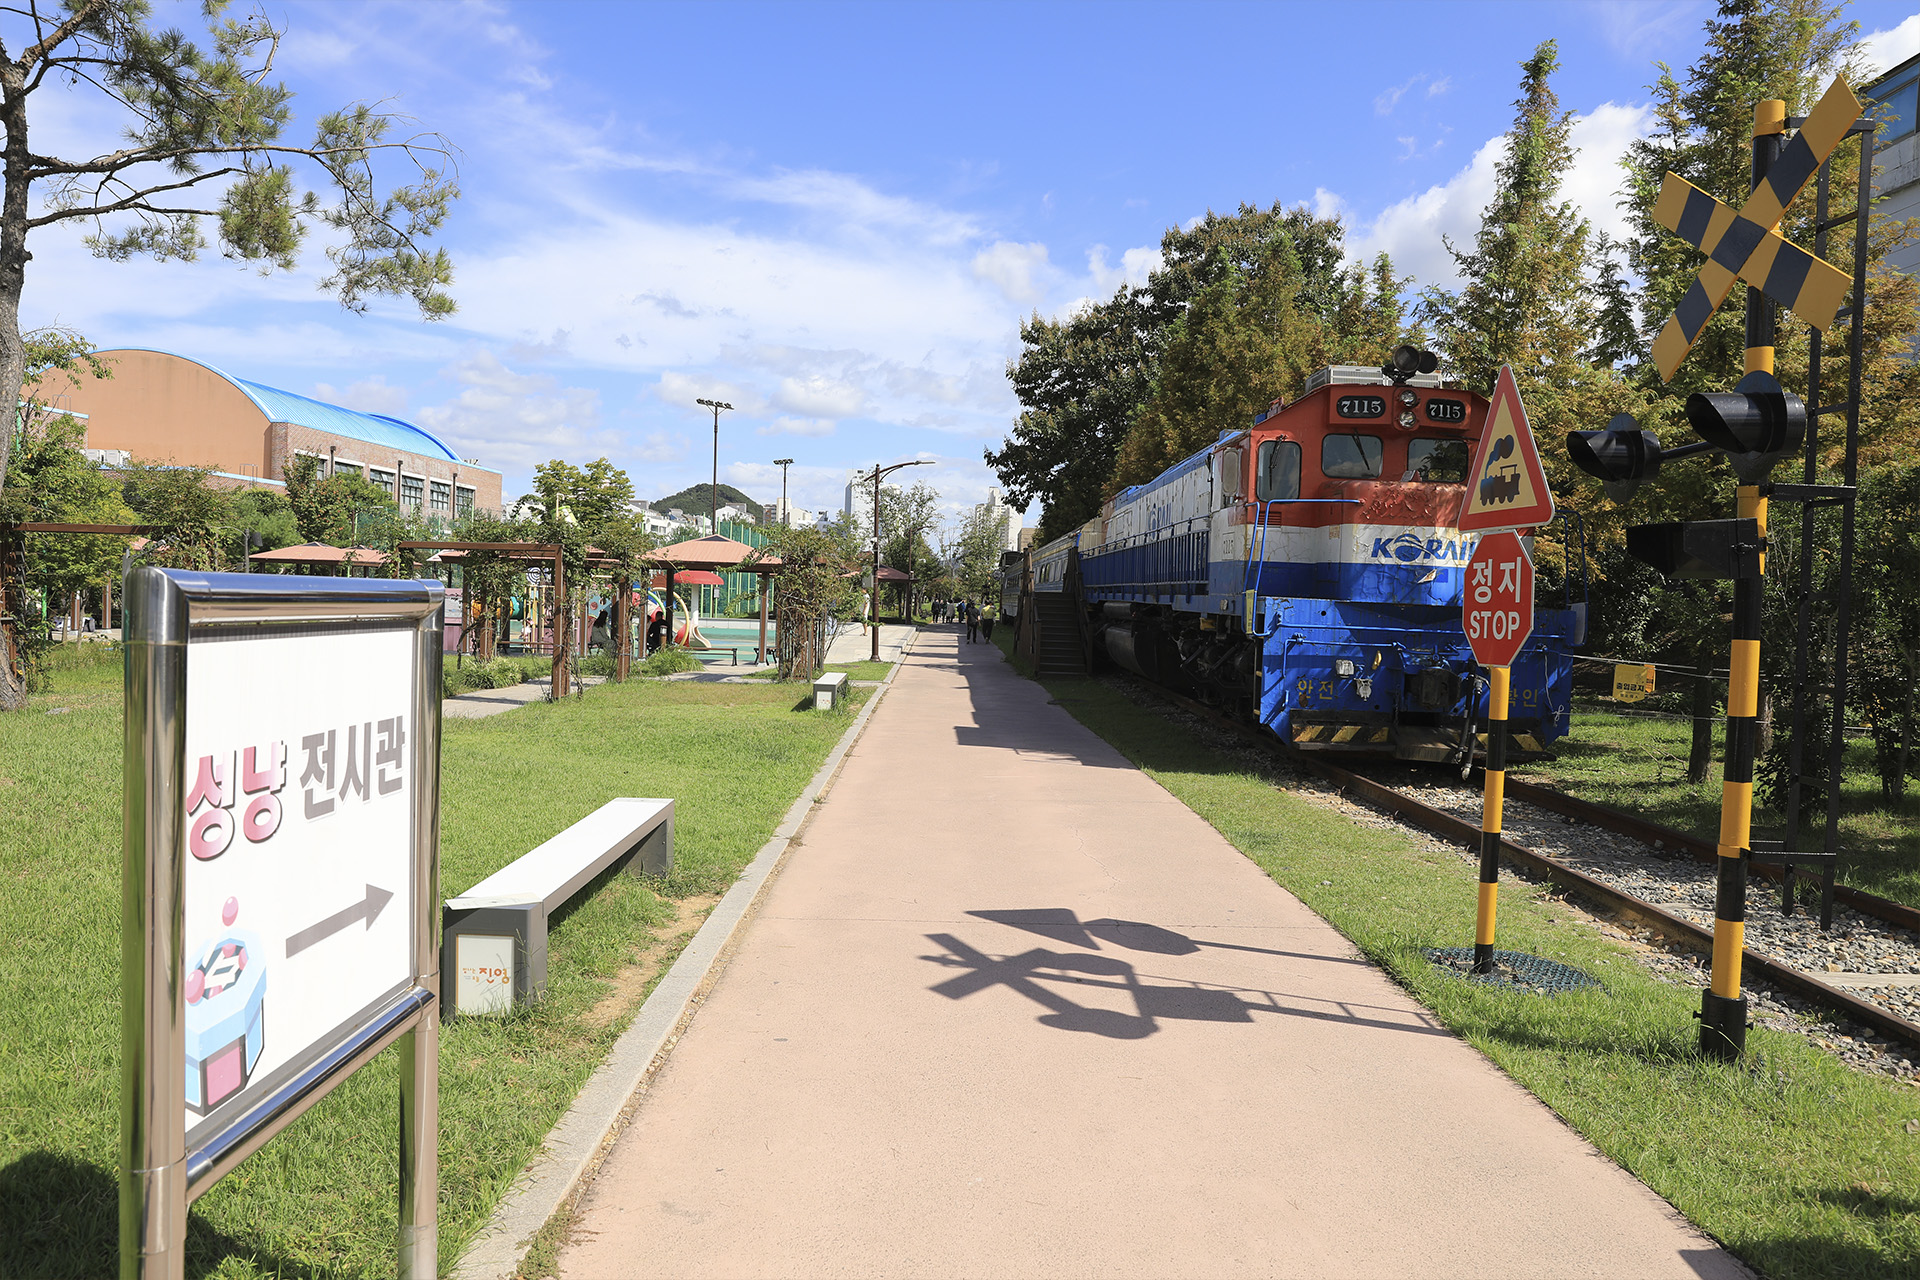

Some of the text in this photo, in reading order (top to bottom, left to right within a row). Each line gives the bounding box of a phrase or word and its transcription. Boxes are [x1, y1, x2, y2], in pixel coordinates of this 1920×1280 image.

[1341, 400, 1382, 414] 7115
[1430, 404, 1461, 419] 7115
[1471, 556, 1523, 603] 정지
[1469, 610, 1520, 640] STOP
[1297, 679, 1334, 700] 안전
[186, 715, 406, 862] 성냥 전시관
[479, 967, 510, 985] 진영
